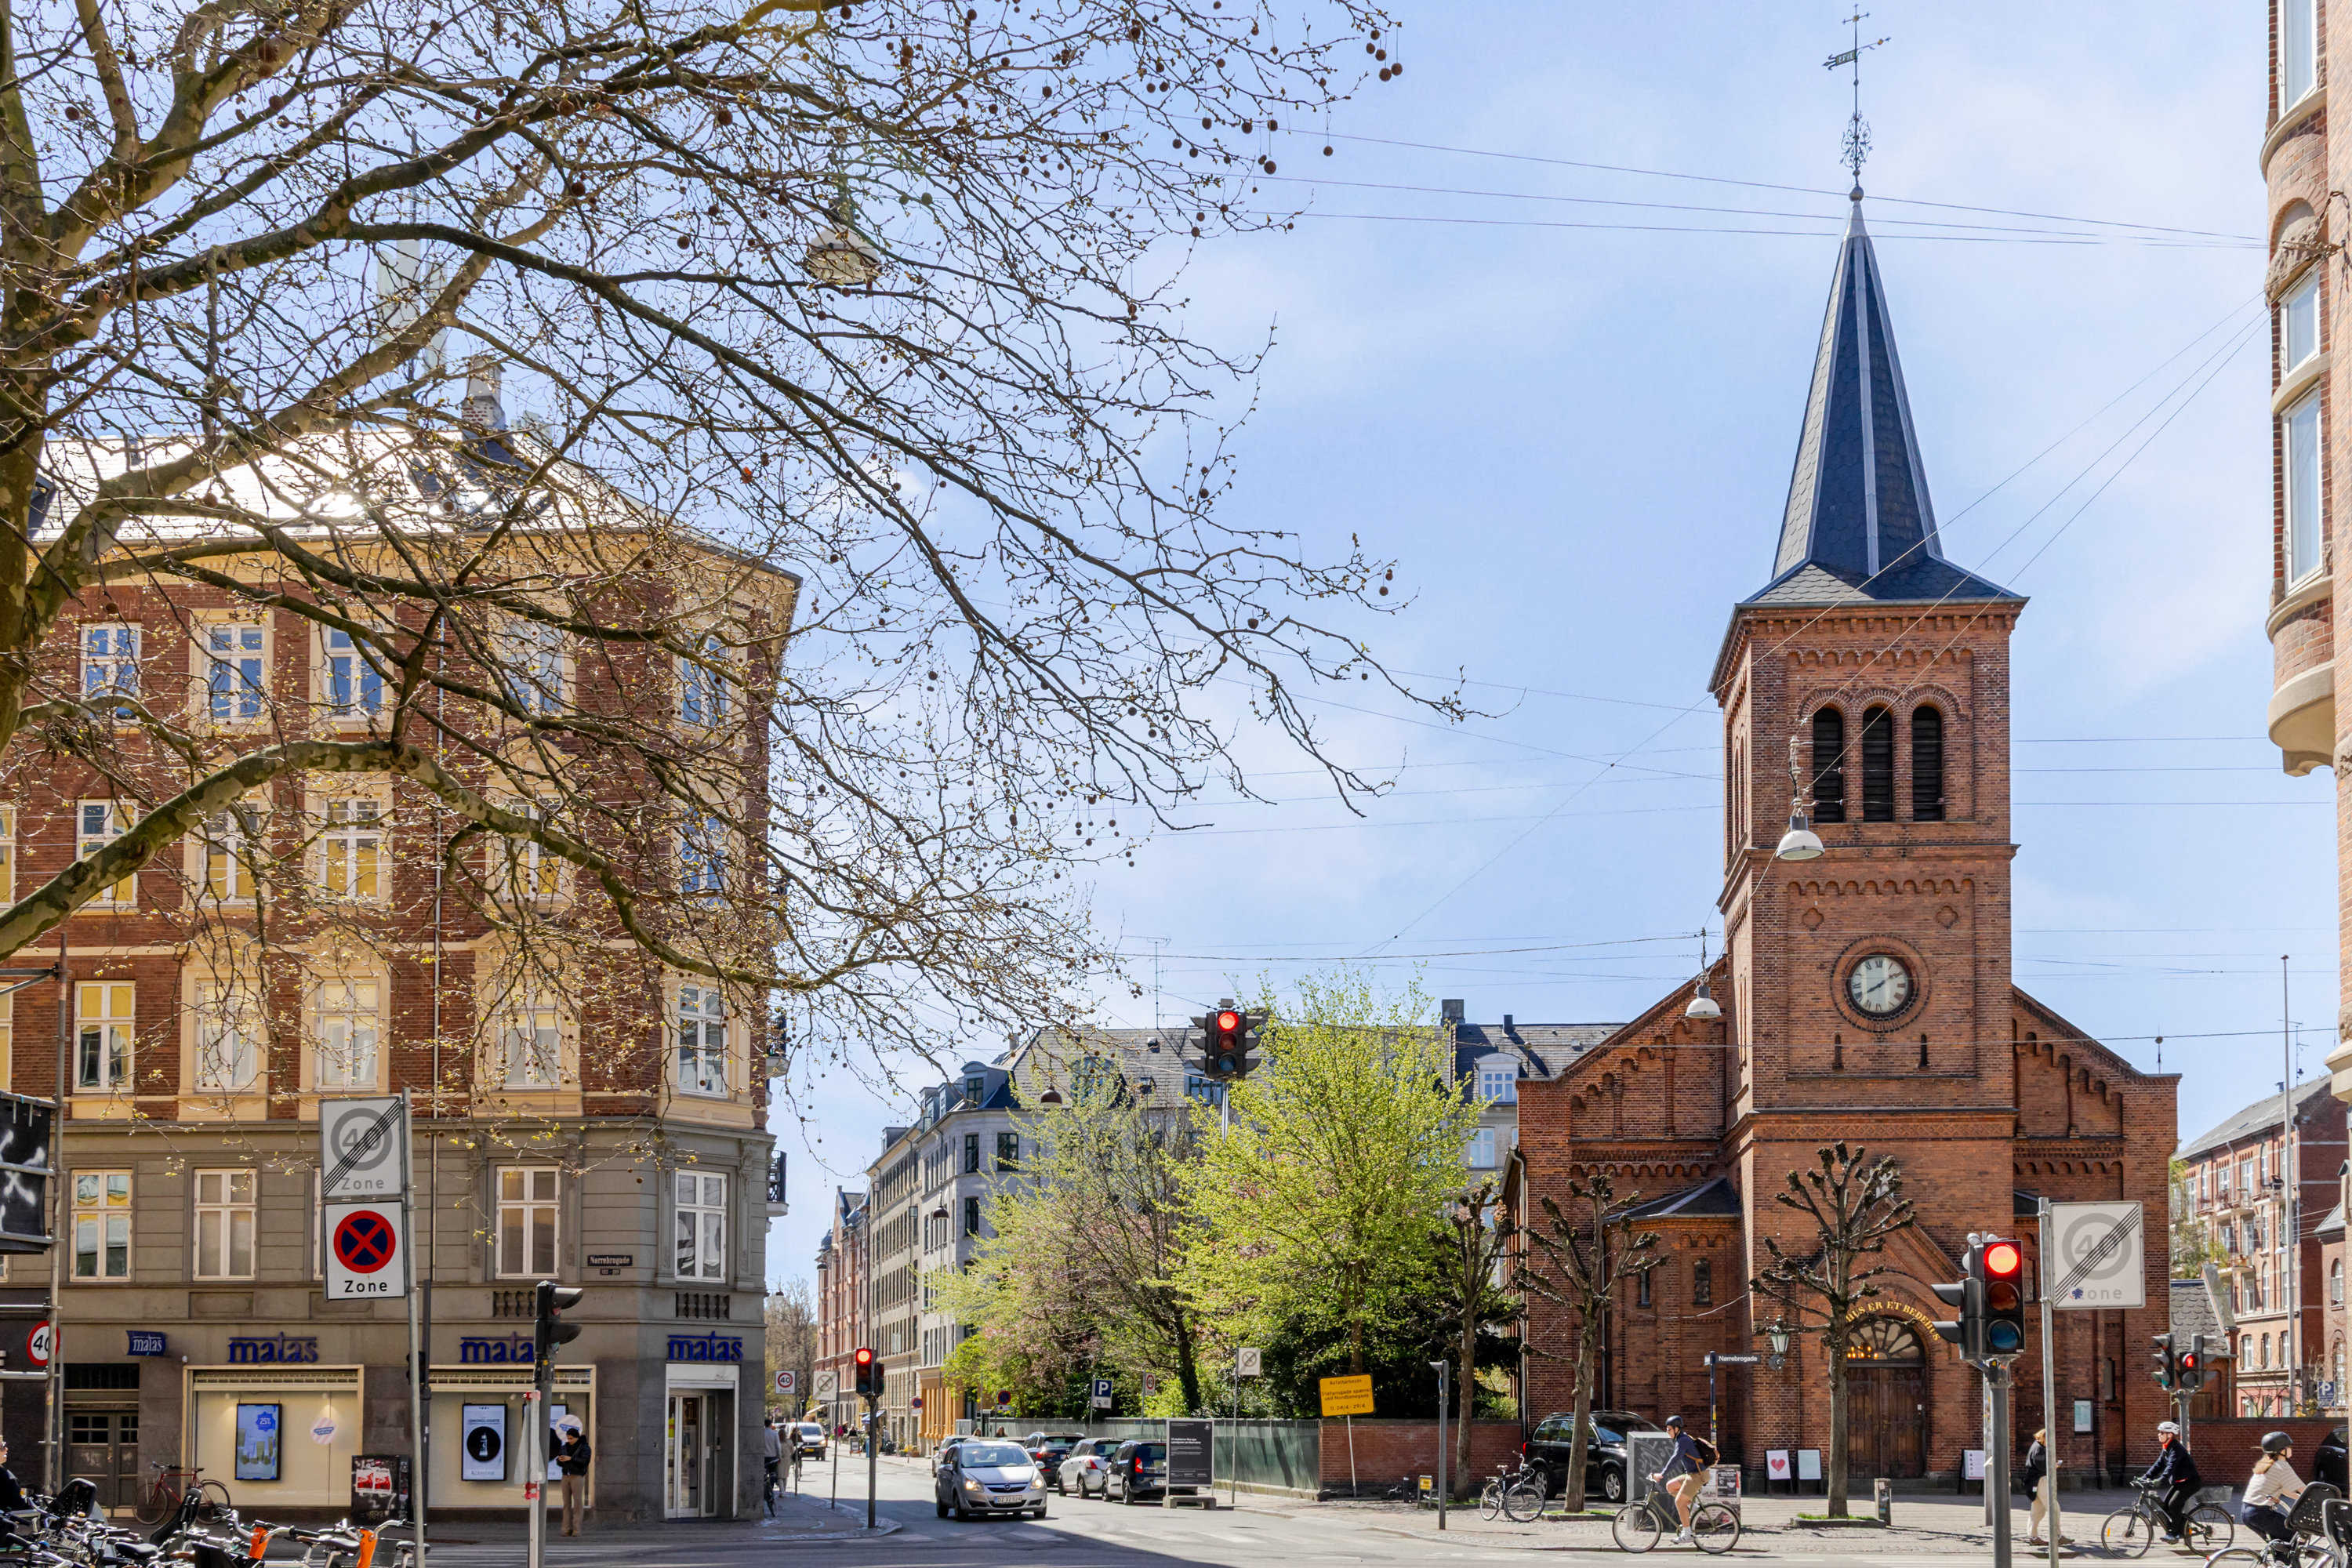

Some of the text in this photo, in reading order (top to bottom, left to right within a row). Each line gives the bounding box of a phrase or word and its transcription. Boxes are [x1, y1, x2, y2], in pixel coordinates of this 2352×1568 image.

[342, 1127, 382, 1151] 40
[341, 1178, 384, 1190] Zone
[2074, 1234, 2119, 1259] 40
[590, 1256, 630, 1266] Nørrebrogade
[344, 1280, 387, 1293] Zone
[2078, 1287, 2123, 1299] one
[1845, 1301, 1940, 1341] HUS ER ET BEDEHUS
[132, 1334, 163, 1352] matas
[226, 1330, 318, 1363] matas
[459, 1330, 535, 1363] mata
[667, 1330, 744, 1362] matas
[1098, 1381, 1109, 1396] P
[2321, 1381, 2332, 1396] P
